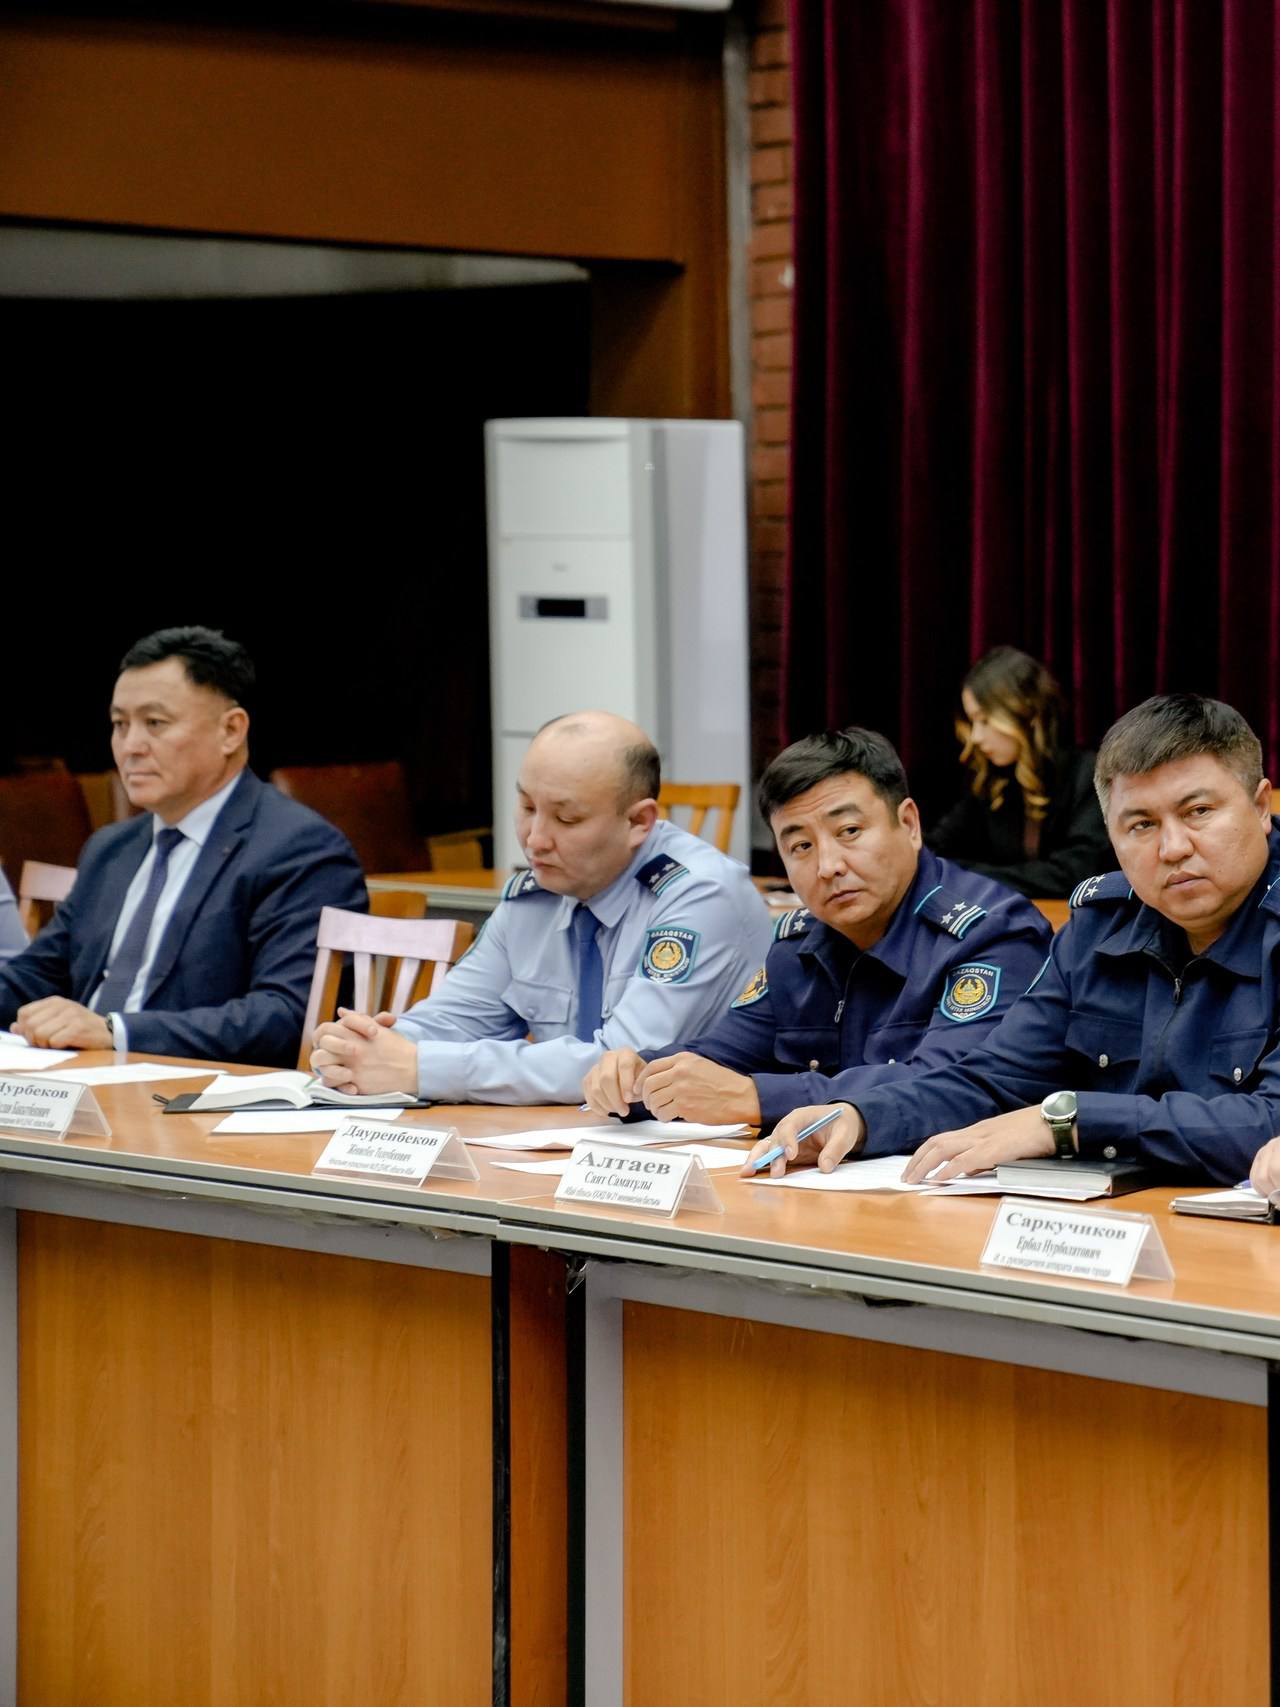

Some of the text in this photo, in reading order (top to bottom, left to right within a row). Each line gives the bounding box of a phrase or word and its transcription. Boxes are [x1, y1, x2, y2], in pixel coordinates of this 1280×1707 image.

[342, 1125, 438, 1146] Дауренбеков
[577, 1152, 671, 1175] Алтаев
[584, 1171, 607, 1185] Саят
[1006, 1211, 1127, 1240] Саркучиков
[1016, 1236, 1041, 1254] Ербол
